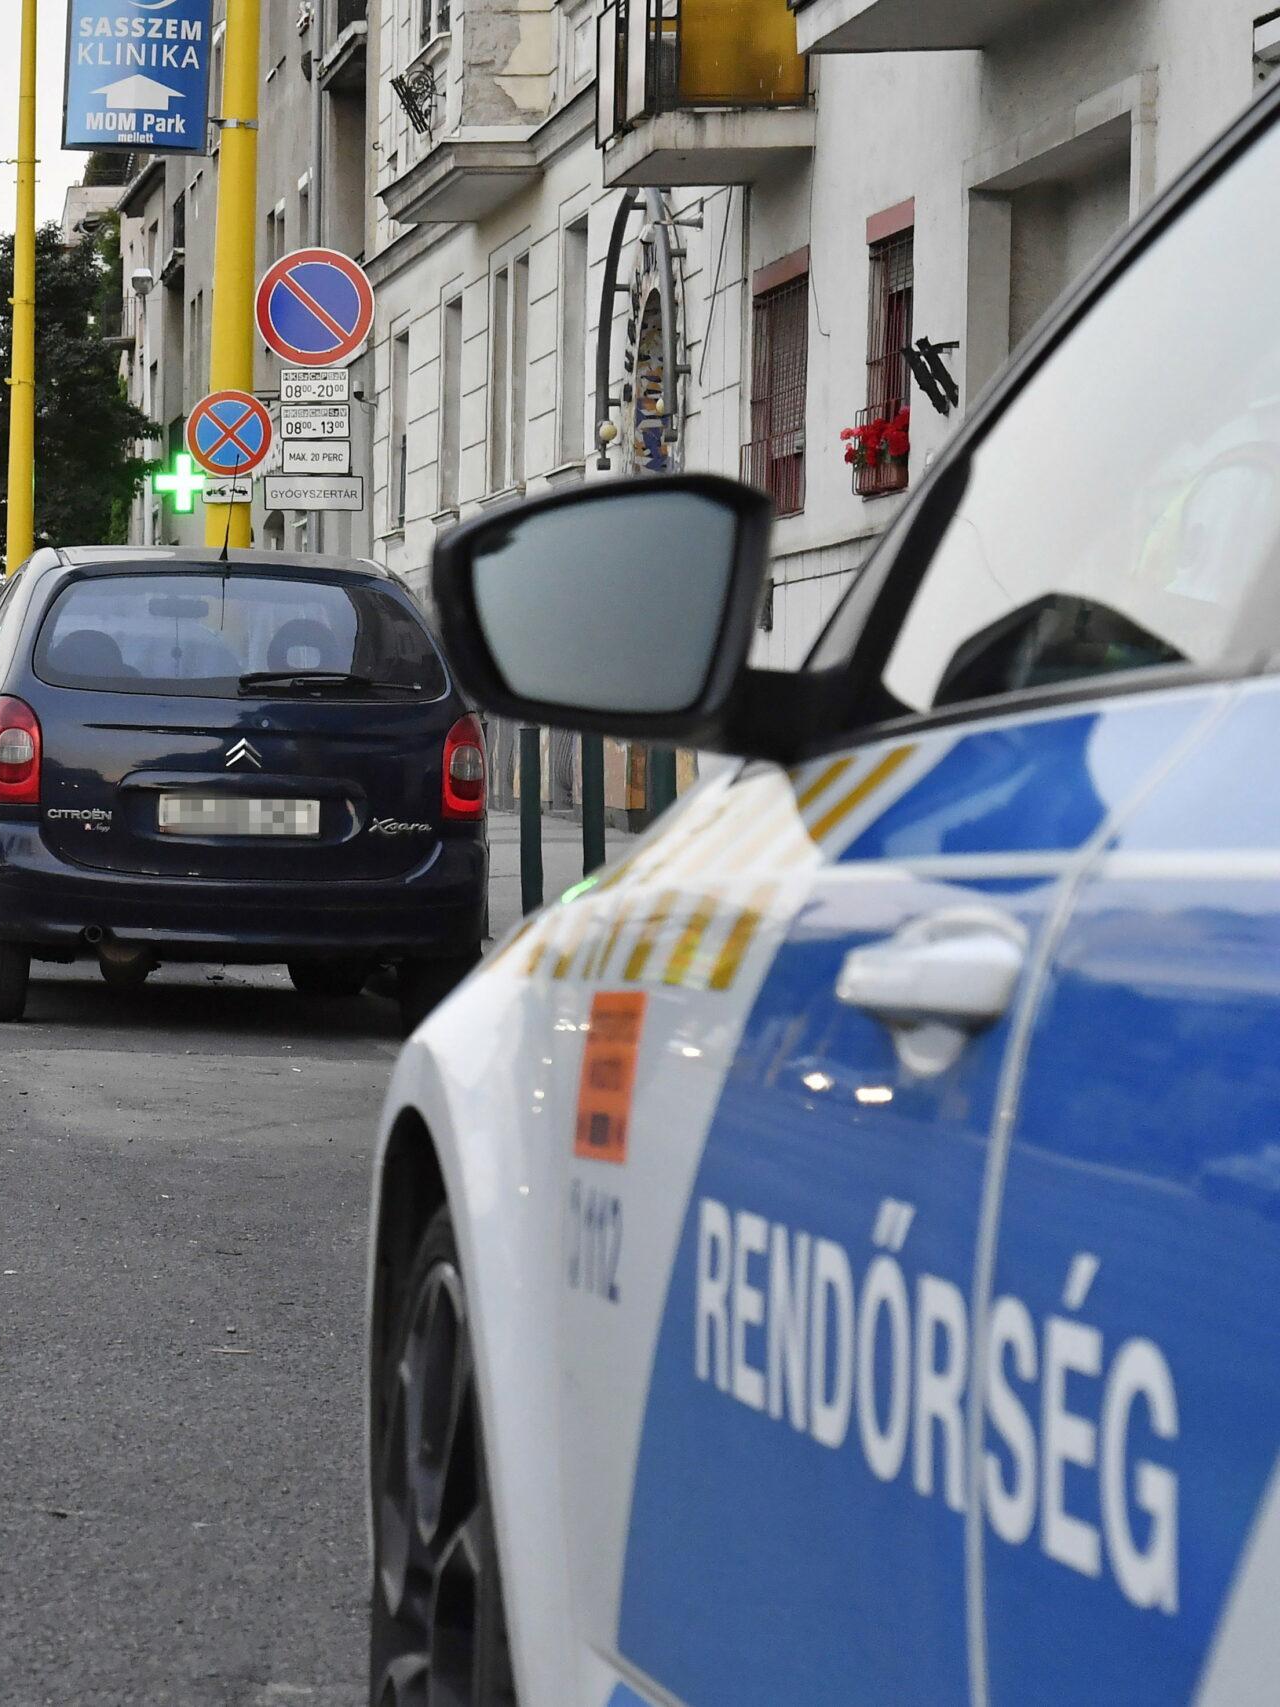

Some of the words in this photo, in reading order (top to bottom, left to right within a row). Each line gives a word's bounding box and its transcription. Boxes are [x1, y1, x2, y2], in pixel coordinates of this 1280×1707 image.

[79, 17, 202, 41] SASSZEM
[78, 42, 200, 70] KLINIKA
[86, 111, 137, 131] MOM
[143, 113, 186, 134] Park
[117, 132, 154, 143] mellett
[289, 453, 308, 462] MAX.
[310, 453, 320, 462] 20
[322, 453, 344, 462] PERC
[270, 488, 358, 499] GYÓGYSZERTÁR
[47, 808, 113, 820] CITROËN
[695, 1195, 1182, 1619] RENDŐRSÉG
